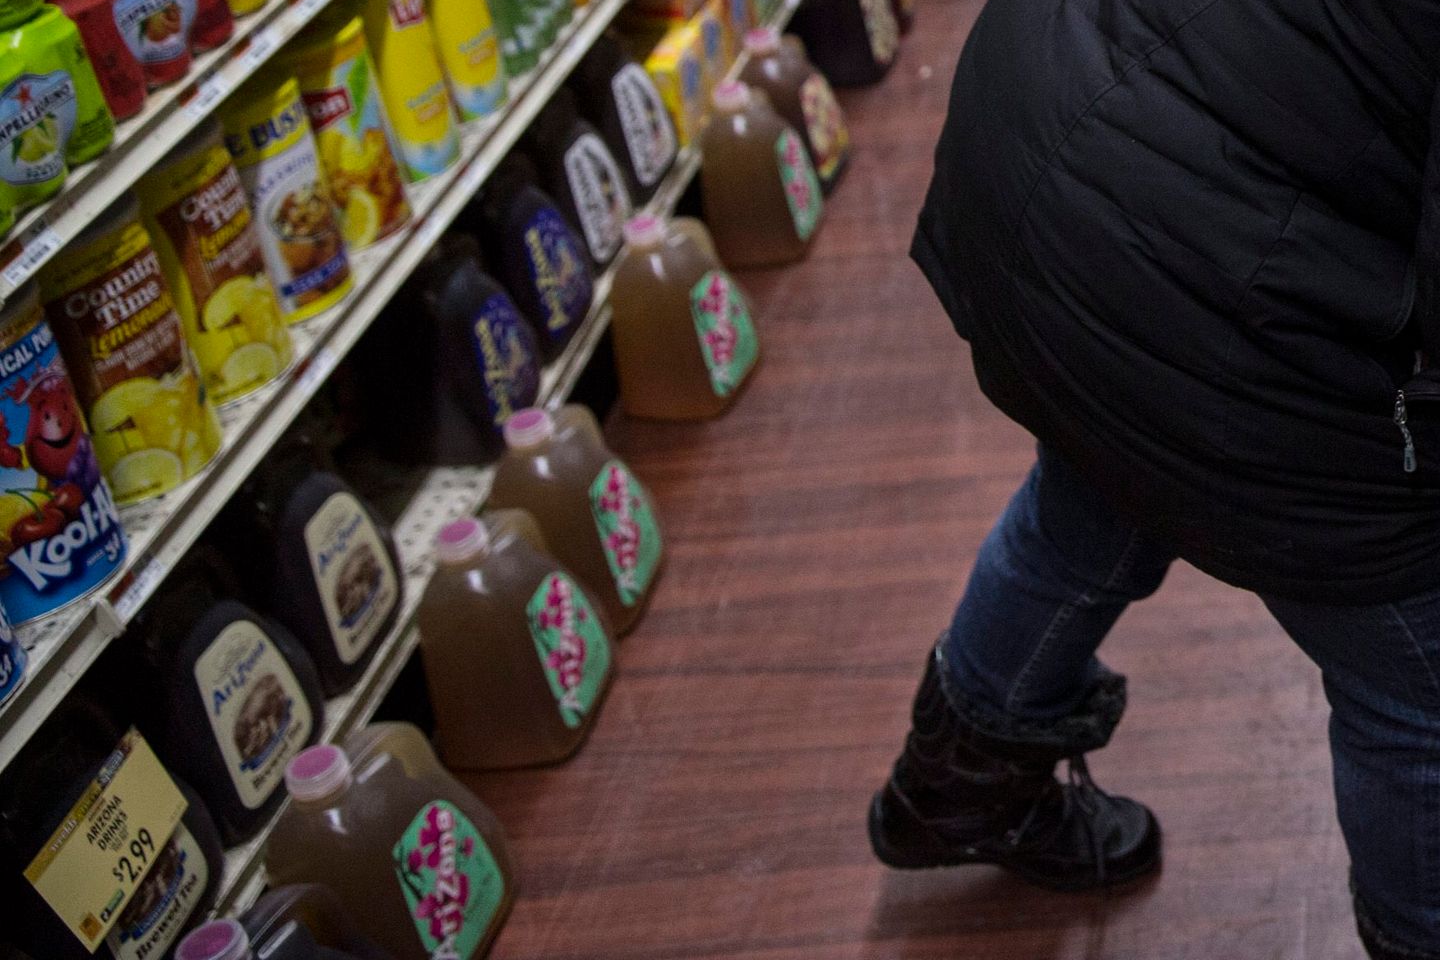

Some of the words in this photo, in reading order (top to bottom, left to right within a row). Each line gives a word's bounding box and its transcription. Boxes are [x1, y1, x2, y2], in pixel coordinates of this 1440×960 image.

[95, 279, 161, 329] Time
[0, 341, 34, 380] ICAL
[8, 480, 121, 592] Kool-A
[86, 794, 123, 845] ARIZONA
[97, 811, 129, 852] DRINKS
[112, 827, 156, 883] $2.99
[134, 895, 183, 960] Brewed
